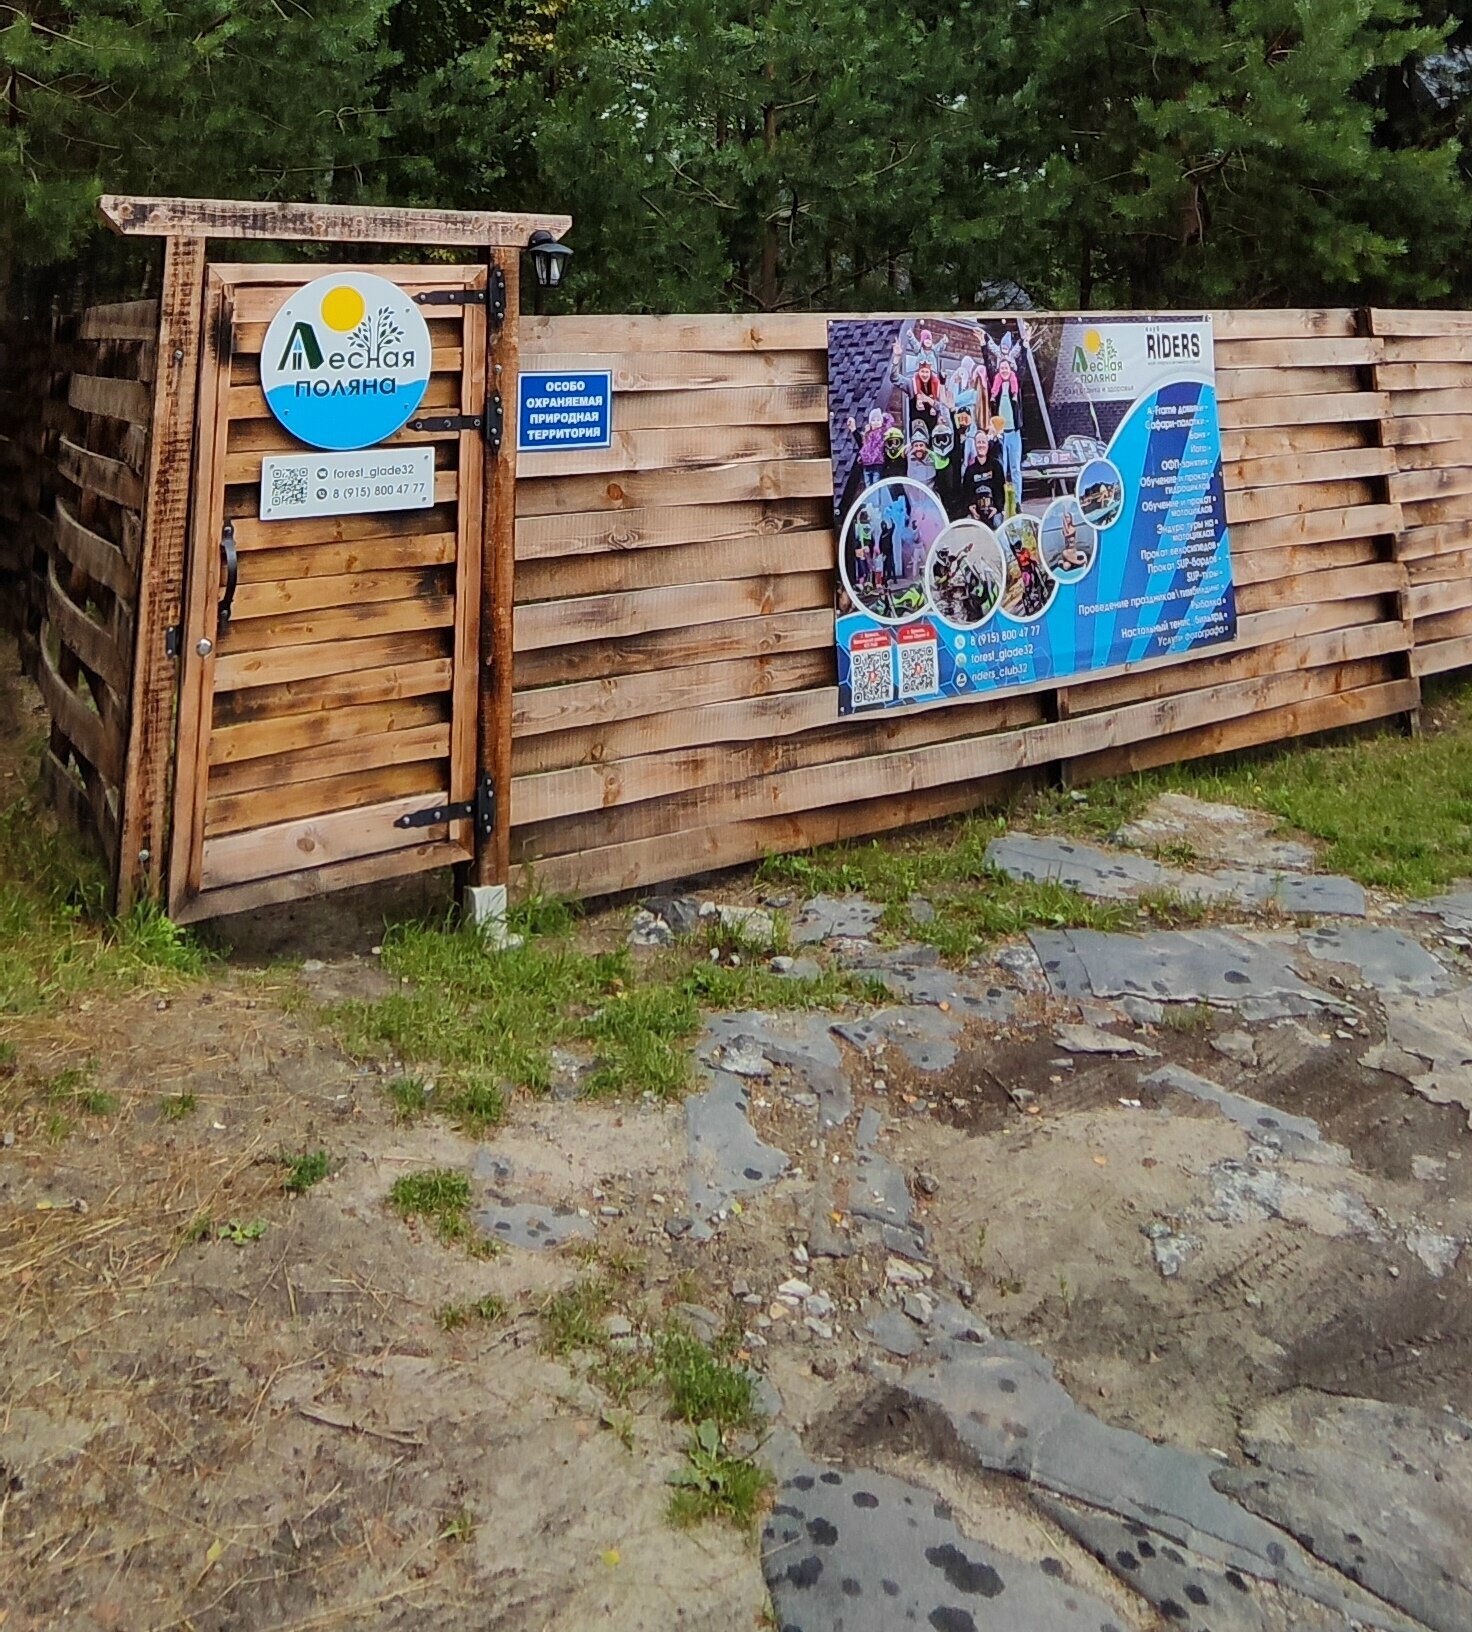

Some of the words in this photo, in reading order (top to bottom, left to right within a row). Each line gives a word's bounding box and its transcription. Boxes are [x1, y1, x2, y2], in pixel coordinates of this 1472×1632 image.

[277, 320, 415, 371] Лесная
[1146, 333, 1200, 359] RIDERS
[1071, 345, 1123, 373] Лесная
[545, 380, 586, 392] ОСОБО
[1080, 372, 1117, 384] поляна
[295, 377, 396, 397] поляна
[526, 395, 603, 409] ОХРАНЯЕМАЯ
[529, 411, 599, 424] ПРИРОДНАЯ
[526, 427, 601, 441] ТЕРРИТОРИЯ
[333, 464, 415, 479] forest_glade32
[1140, 475, 1177, 488] Обучение
[333, 488, 340, 499] 8
[343, 486, 371, 499] (915)
[374, 485, 394, 496] 800
[396, 483, 410, 495] 47
[412, 482, 425, 494] 77
[1141, 500, 1179, 513] Обучение
[1140, 548, 1168, 562] Прокат
[1147, 562, 1175, 575] Прокат
[1078, 599, 1130, 617] Проведение
[970, 635, 976, 647] 8
[977, 632, 1000, 647] (915)
[1001, 629, 1017, 642] 800
[1018, 627, 1029, 638] 47
[1030, 624, 1041, 637] 77
[1121, 620, 1169, 639] Настольный
[971, 643, 1034, 664] forest_glade32
[971, 662, 1028, 683] riders_club32
